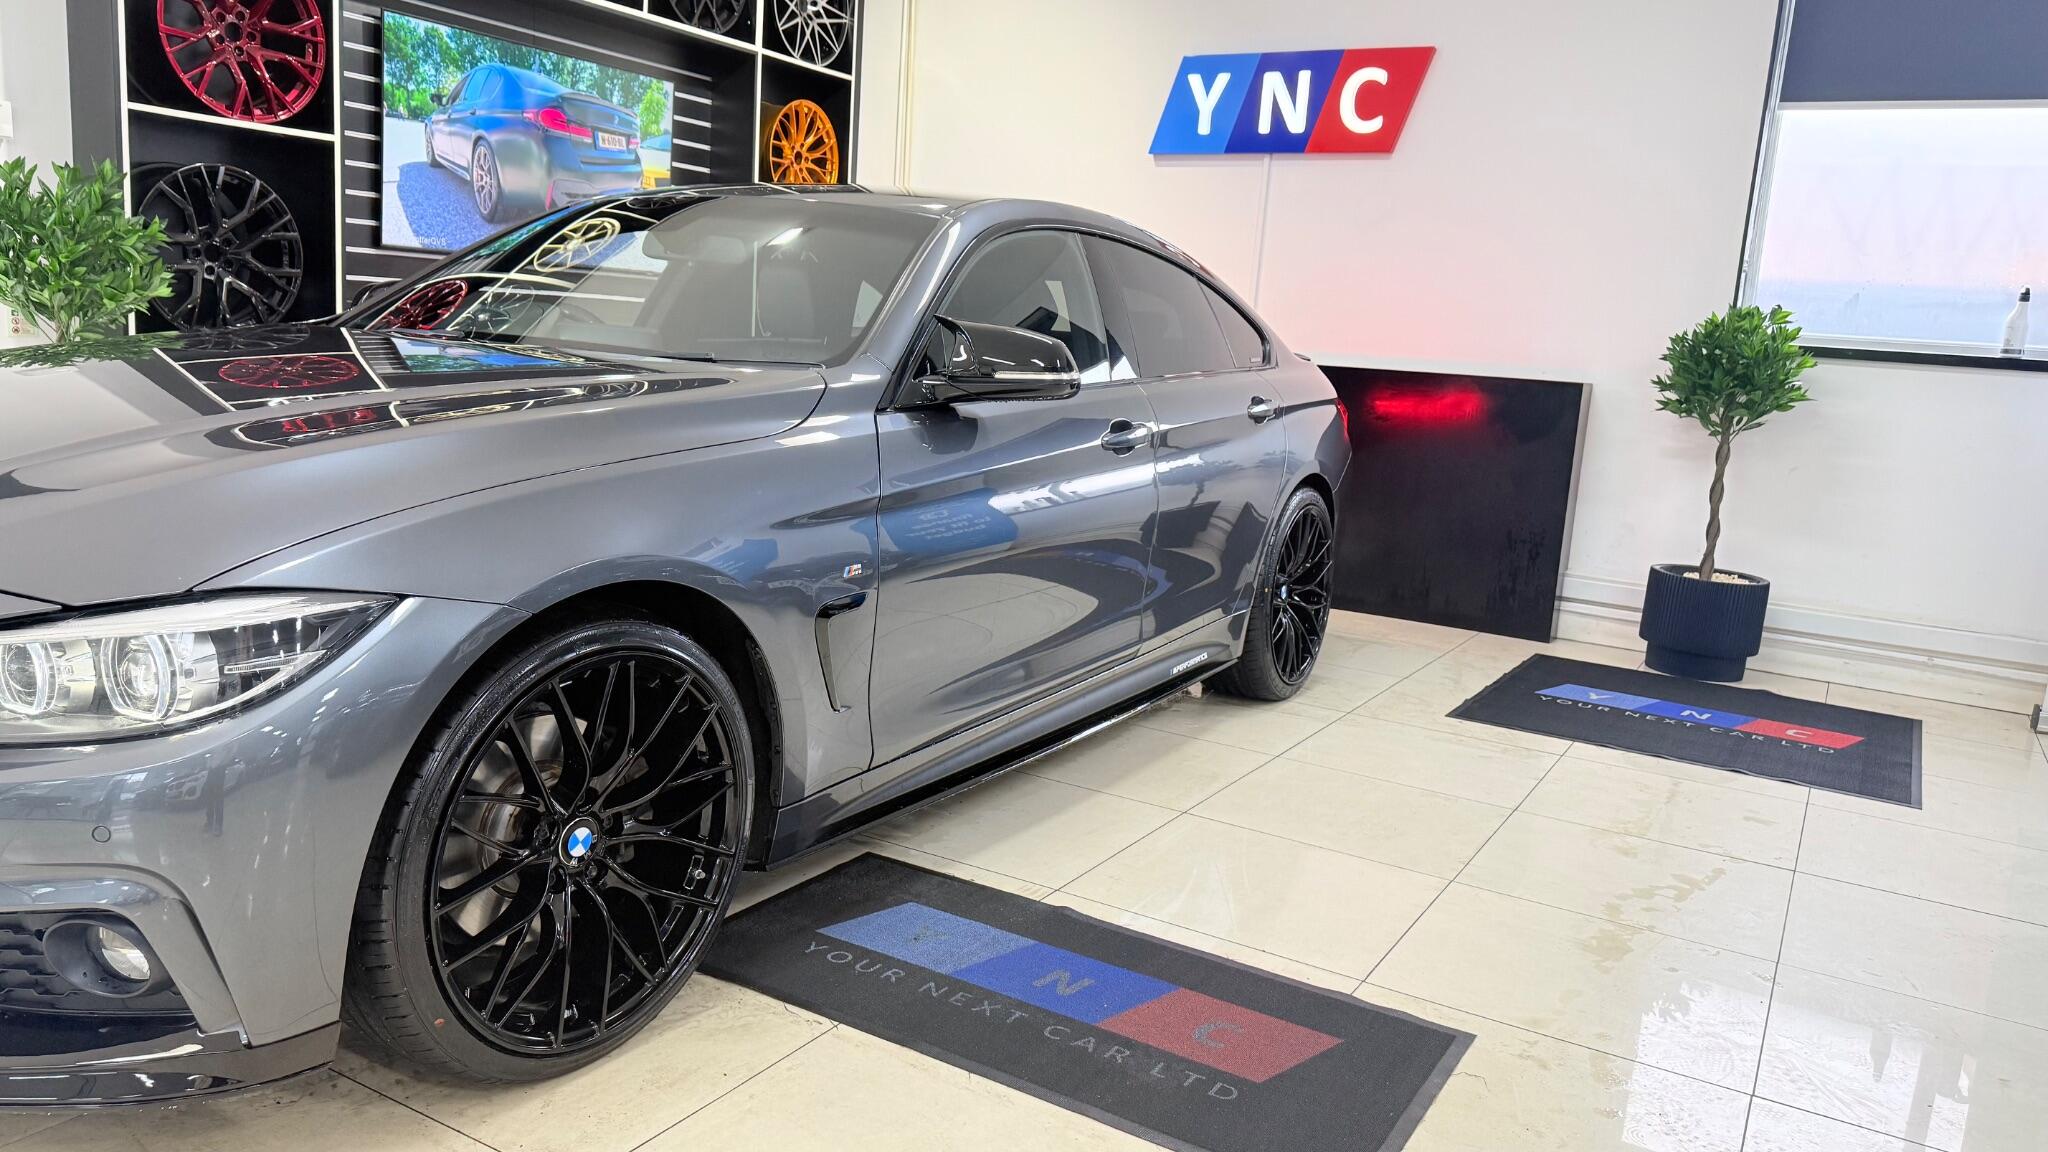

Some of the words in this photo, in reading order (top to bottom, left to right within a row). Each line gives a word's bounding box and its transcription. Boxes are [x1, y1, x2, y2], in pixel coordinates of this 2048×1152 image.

[1187, 66, 1388, 135] YNC
[1540, 695, 1610, 712] YOUR
[1624, 711, 1696, 727] NEXT
[1709, 727, 1765, 742] CAR
[1781, 739, 1834, 754] LTD
[805, 941, 905, 984] YOUR
[917, 981, 1029, 1024] NEXT
[1043, 1025, 1131, 1064] CAR
[1150, 1062, 1238, 1101] LTD
